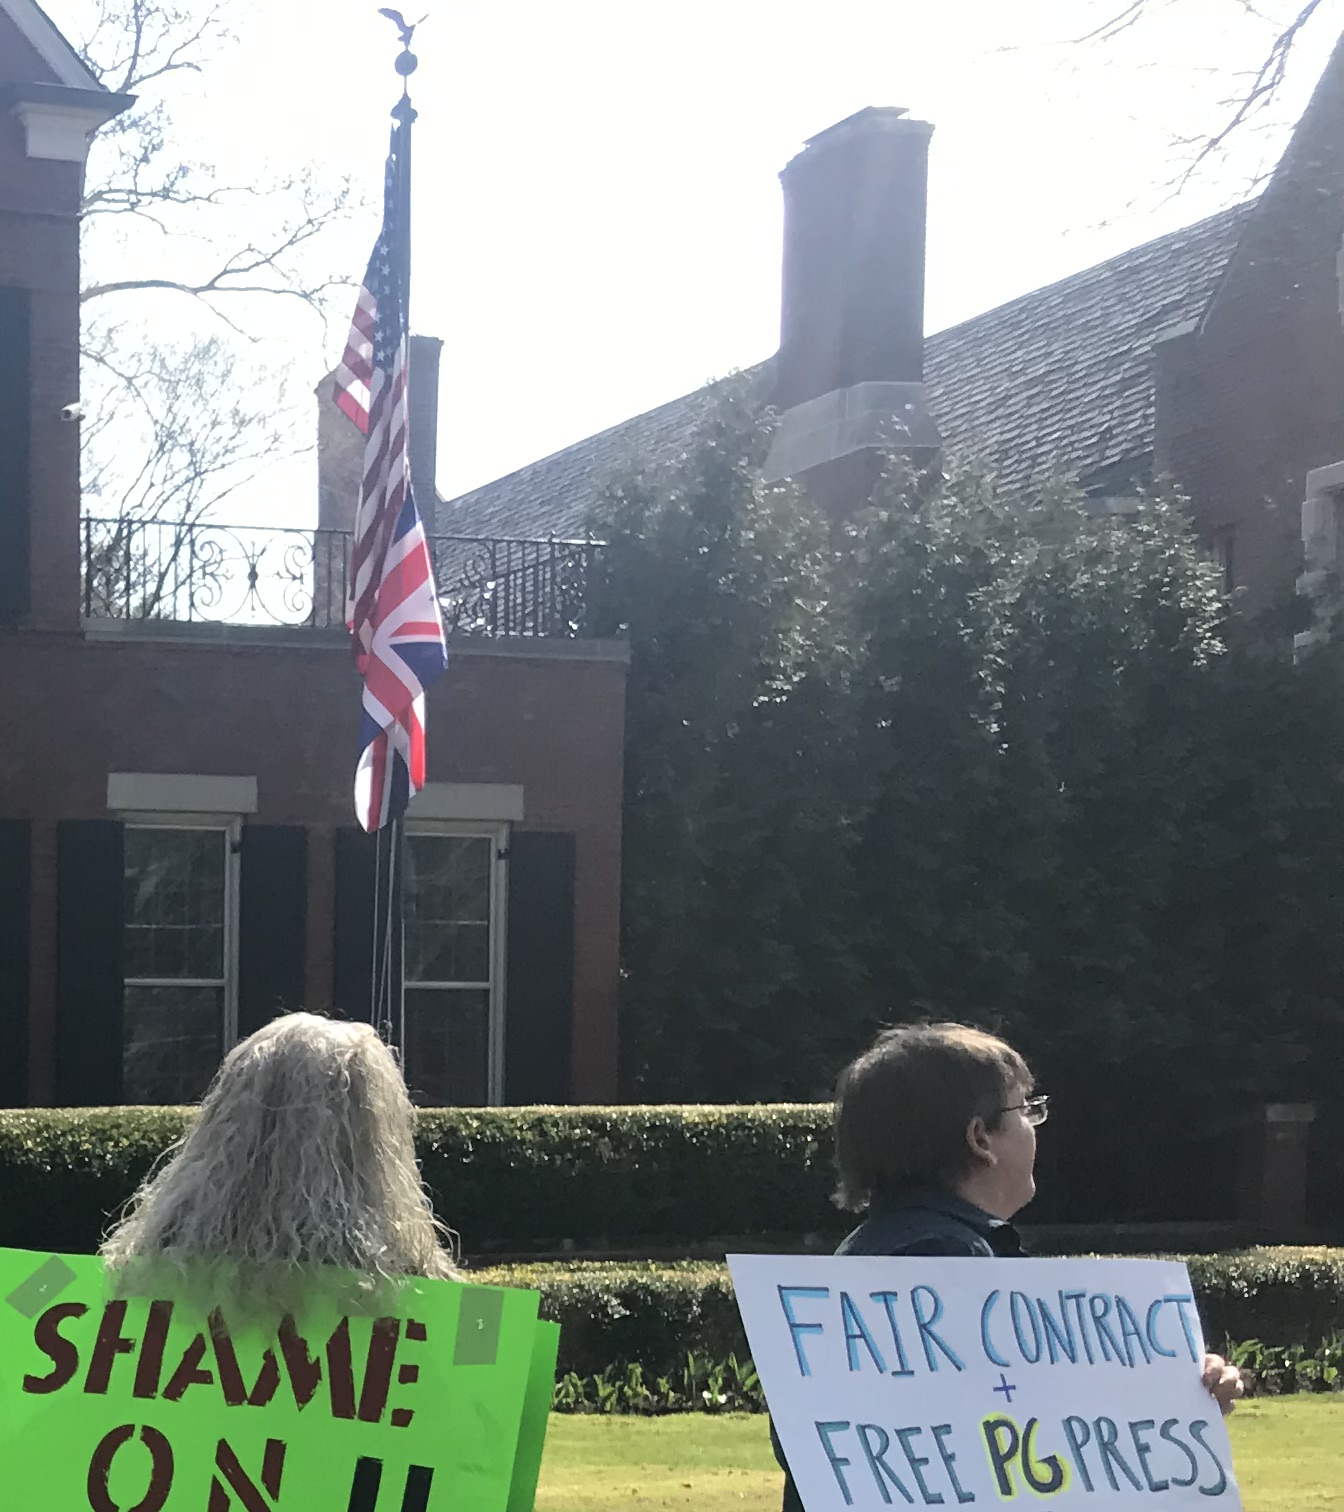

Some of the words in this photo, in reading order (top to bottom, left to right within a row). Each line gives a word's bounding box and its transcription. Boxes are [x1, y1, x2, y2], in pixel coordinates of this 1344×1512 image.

[21, 1300, 428, 1428] SHAME
[777, 1284, 966, 1377] FAIR
[980, 1288, 1200, 1368] CONTRACT
[815, 1419, 976, 1505] FREE
[982, 1417, 1065, 1496] PG
[1062, 1415, 1229, 1496] PRESS
